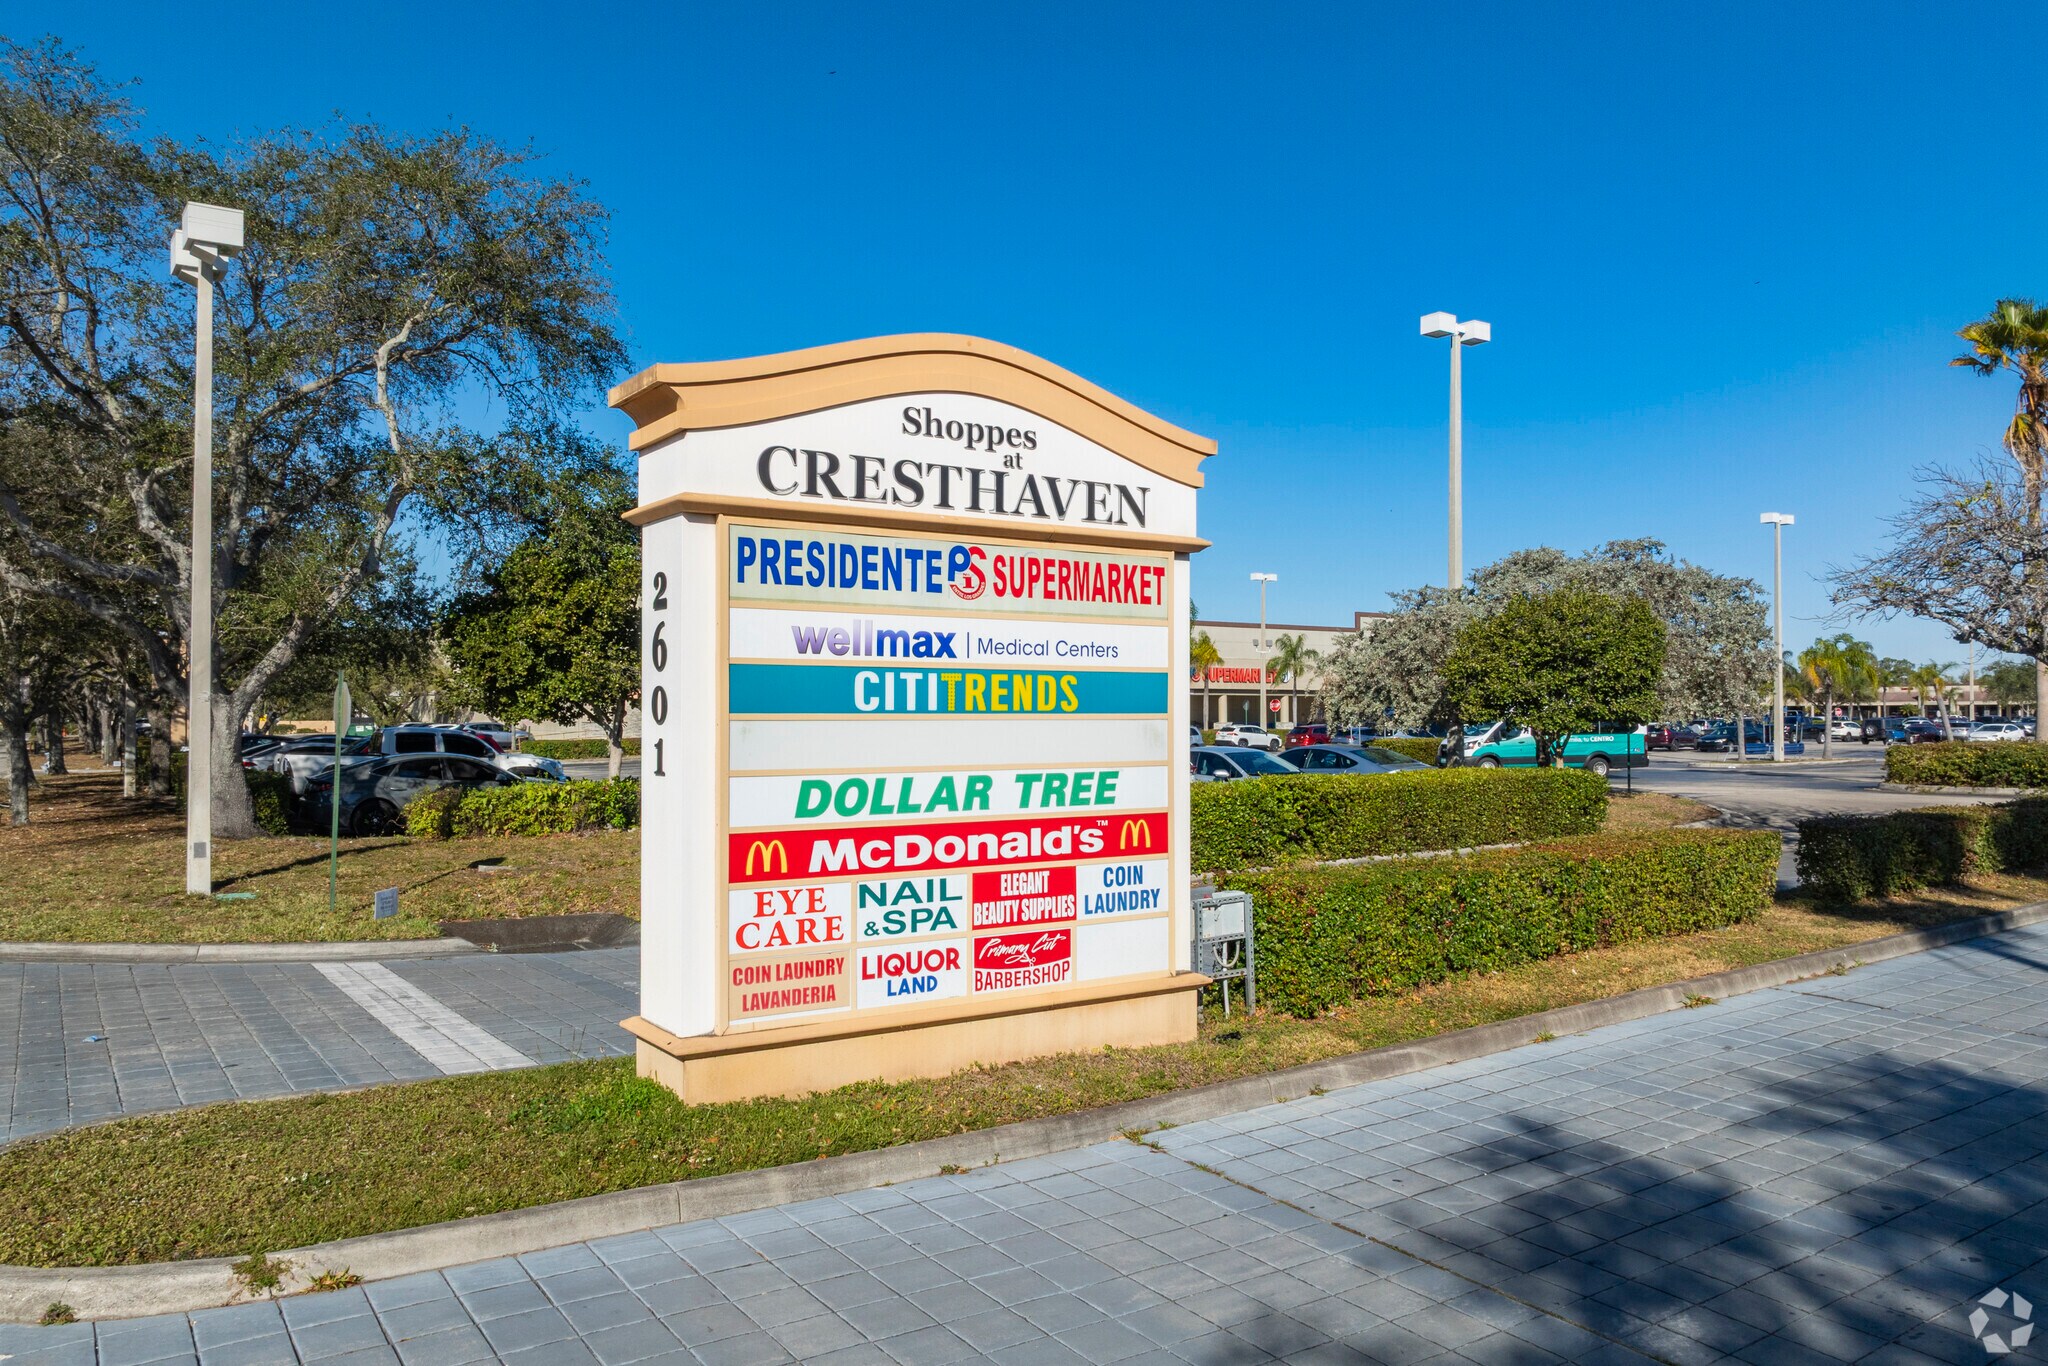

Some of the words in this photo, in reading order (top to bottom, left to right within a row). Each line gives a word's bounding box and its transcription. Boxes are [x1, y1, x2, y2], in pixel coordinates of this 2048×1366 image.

[902, 406, 1037, 452] Shoppes
[1003, 452, 1023, 470] at
[756, 445, 1150, 528] CRESTHAVEN
[737, 536, 942, 593] PRESIDENTE
[993, 554, 1165, 605] SUPERMARKET
[791, 618, 957, 659] wellmax
[978, 637, 1049, 656] Medical
[1055, 640, 1119, 659] Centers
[651, 571, 668, 777] 2601
[794, 774, 993, 818] DOLLAR
[1014, 771, 1120, 809] TREE
[808, 825, 1105, 873] McDonald's
[1000, 870, 1050, 897] ELEGANT
[1103, 865, 1143, 888] COIN
[753, 887, 827, 918] EYE
[859, 878, 963, 909] NAIL
[1084, 888, 1160, 915] LAUNDRY
[973, 900, 1020, 926] BEAUTY
[1021, 894, 1075, 922] SUPPLIES
[735, 915, 844, 950] CARE
[1031, 933, 1066, 953] Cut
[732, 965, 771, 986] COIN
[776, 957, 844, 982] LAUNDRY
[861, 947, 961, 981] LIQUOR
[975, 960, 1070, 992] BARBERSHOP
[742, 984, 836, 1012] LAVANDERIA
[887, 975, 938, 997] LAND
